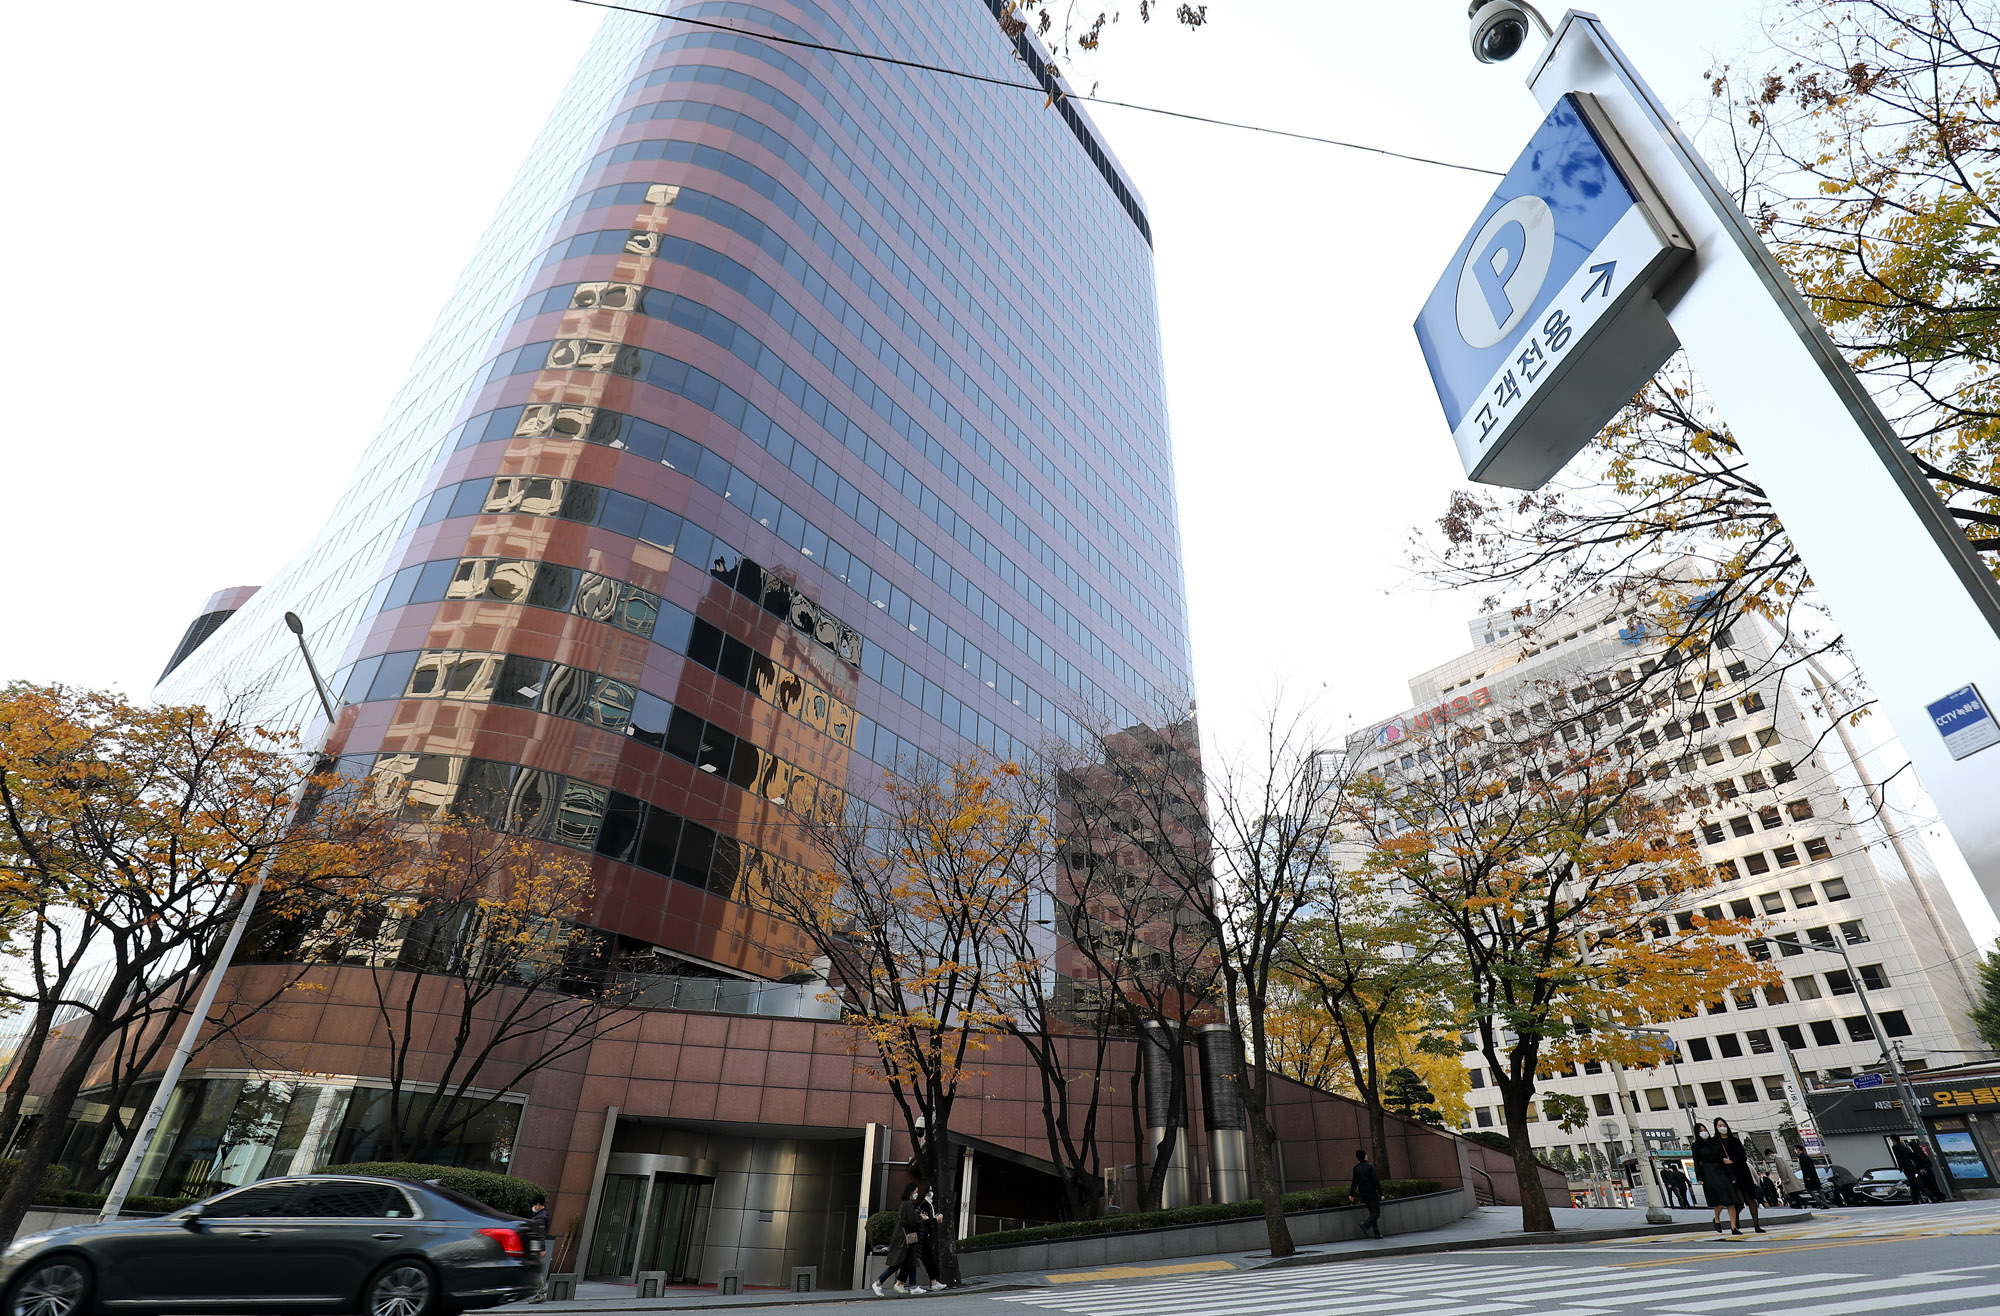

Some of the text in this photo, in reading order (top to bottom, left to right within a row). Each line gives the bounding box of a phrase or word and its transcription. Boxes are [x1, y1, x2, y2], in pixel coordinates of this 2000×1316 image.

[1472, 220, 1526, 330] P
[1474, 309, 1573, 443] 고객전용
[1412, 686, 1493, 731] 사랑으로
